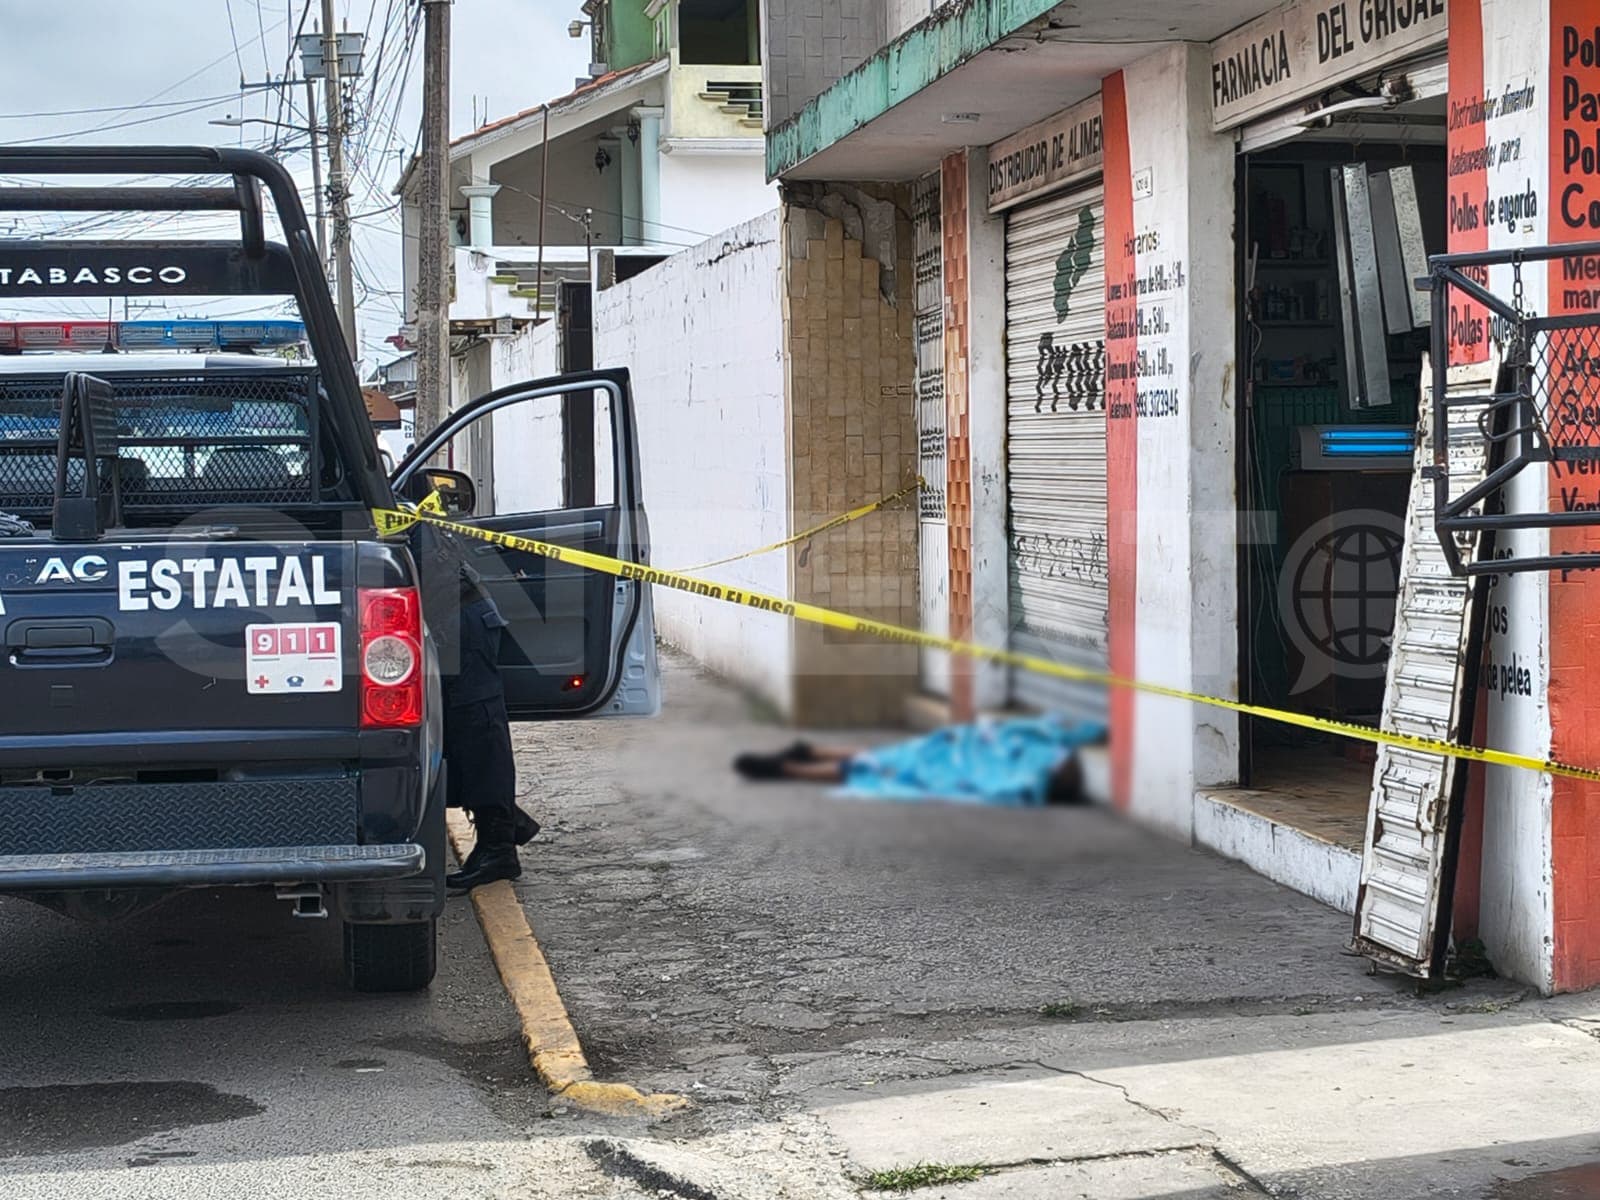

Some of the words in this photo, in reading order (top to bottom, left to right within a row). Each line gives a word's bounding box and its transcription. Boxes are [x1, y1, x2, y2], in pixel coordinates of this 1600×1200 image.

[1211, 29, 1291, 108] FARMACIA
[1316, 2, 1354, 64] DEL
[989, 140, 1047, 195] DISTRIBUIDOR
[1052, 132, 1065, 171] DE
[1451, 192, 1478, 234] Pollos
[1483, 186, 1495, 227] de
[1498, 178, 1537, 233] engorda
[0, 266, 187, 285] TABASCO
[1451, 304, 1483, 348] Pollas
[34, 555, 108, 585] AC
[118, 555, 341, 611] ESTATAL
[620, 564, 722, 600] PROHIBIDO
[1500, 651, 1532, 701] pelea
